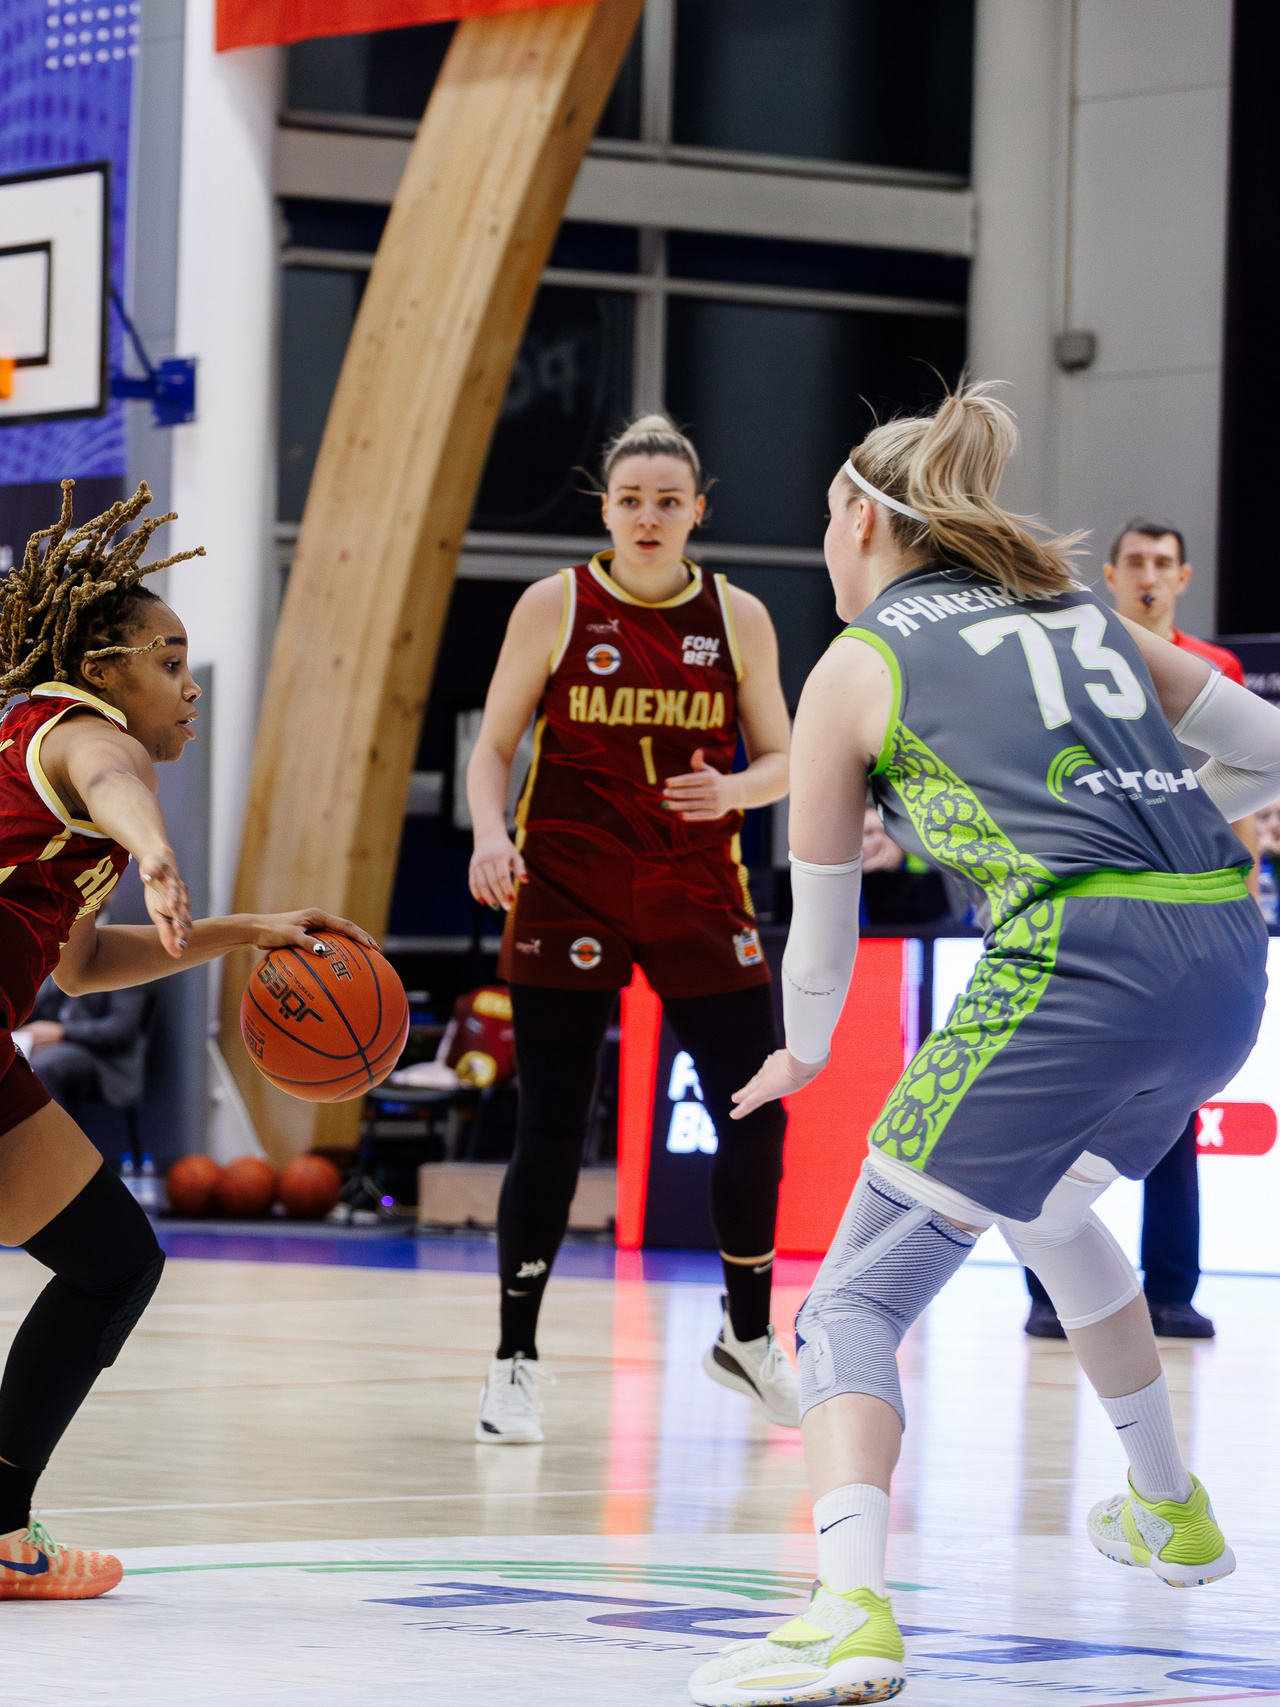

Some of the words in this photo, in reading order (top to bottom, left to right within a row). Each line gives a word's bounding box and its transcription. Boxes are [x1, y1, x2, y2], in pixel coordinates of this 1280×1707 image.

[681, 634, 721, 652] FON
[682, 650, 721, 668] BET
[958, 603, 1147, 730] 73
[568, 685, 726, 731] НАДЕЖДА
[639, 736, 658, 785] 1
[401, 1619, 696, 1653] группа
